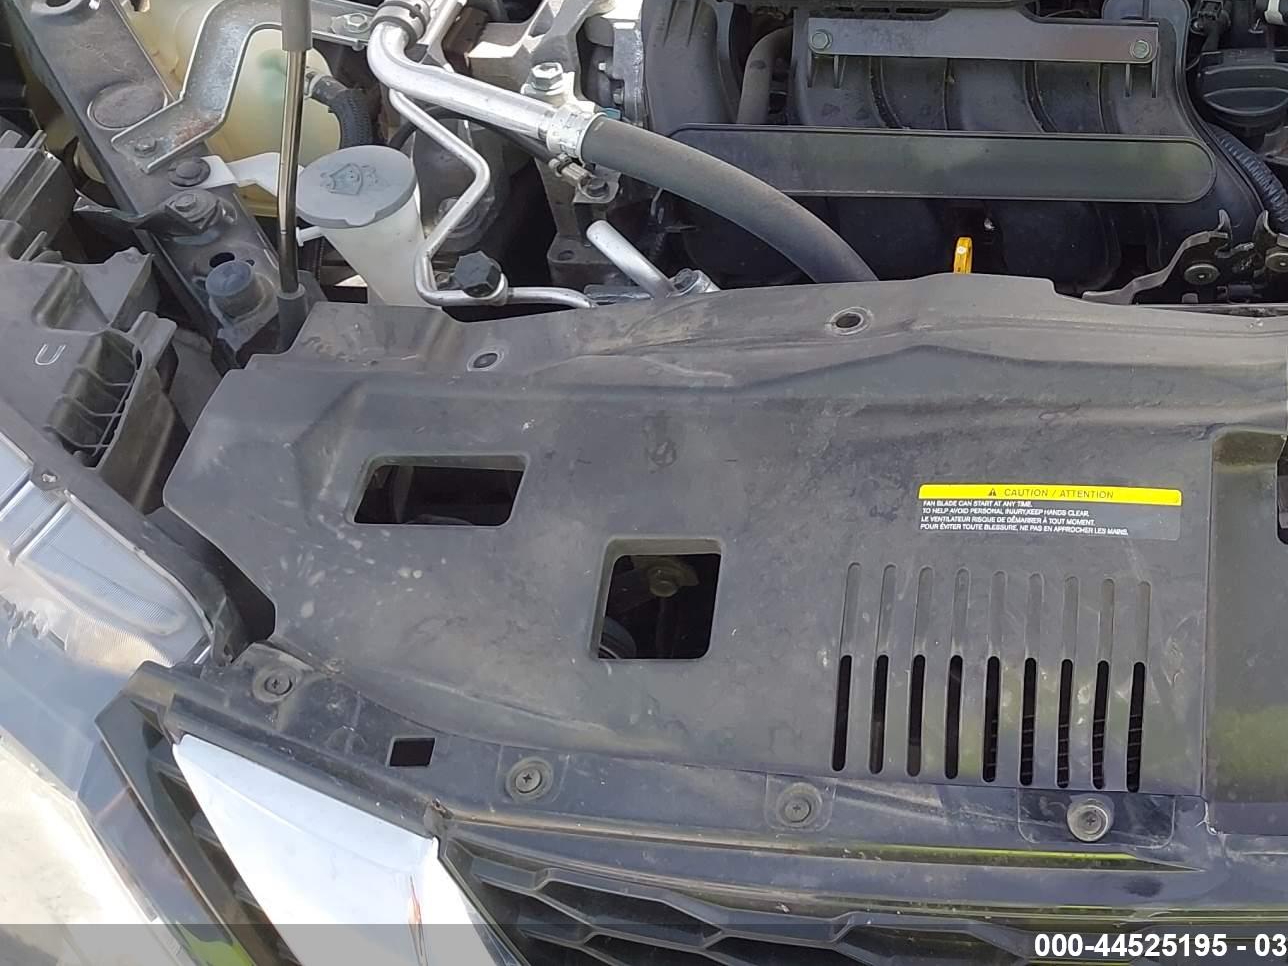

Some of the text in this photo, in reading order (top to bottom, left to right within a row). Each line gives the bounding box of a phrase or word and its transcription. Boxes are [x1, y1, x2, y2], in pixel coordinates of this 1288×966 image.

[1003, 488, 1048, 497] CAUTION
[1059, 489, 1114, 499] ATTENTION
[930, 515, 971, 523] VENTILATEUR
[1006, 515, 1042, 524] DÉMARRER
[1042, 516, 1048, 524] À
[939, 522, 961, 530] ÉVITER
[1053, 526, 1094, 534] APPROCHER
